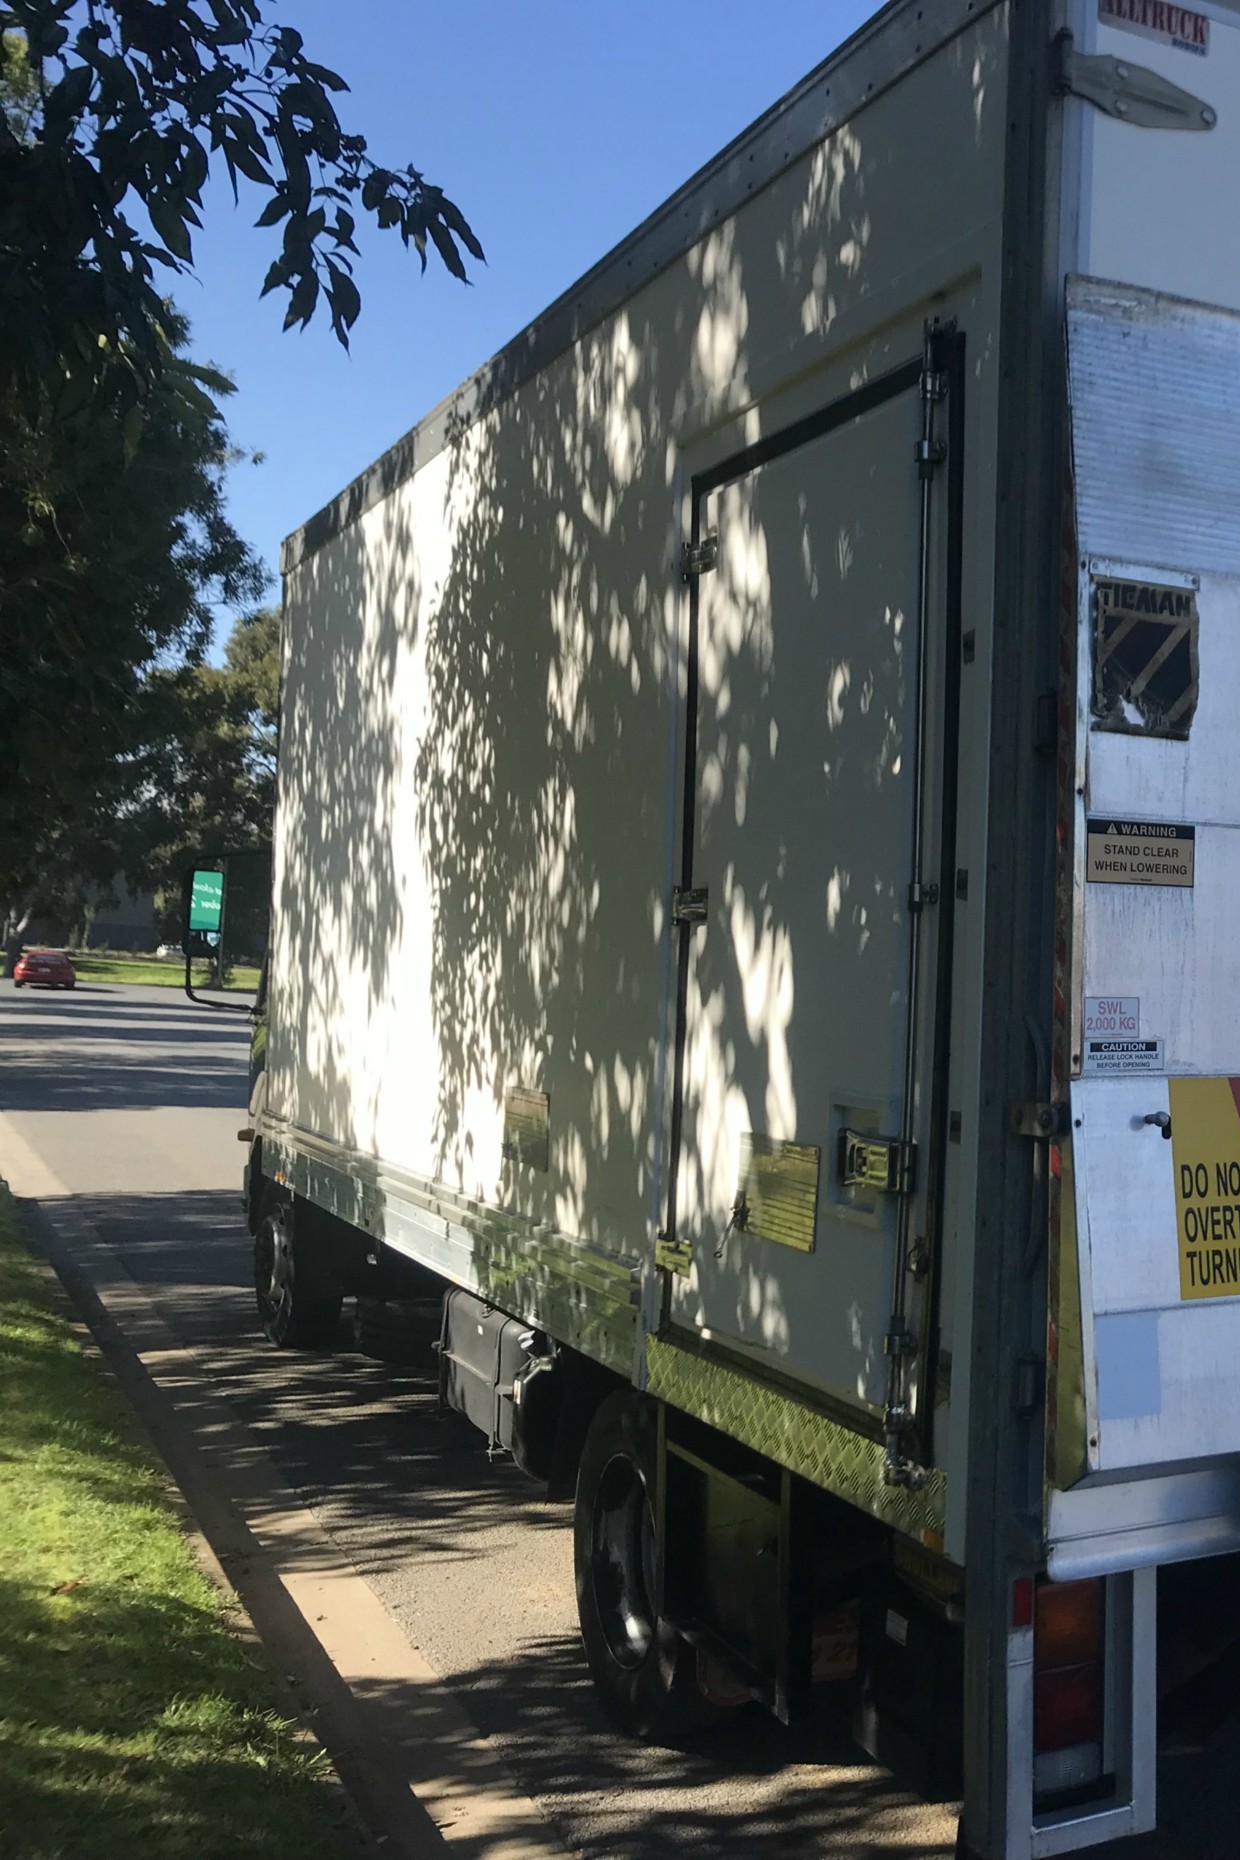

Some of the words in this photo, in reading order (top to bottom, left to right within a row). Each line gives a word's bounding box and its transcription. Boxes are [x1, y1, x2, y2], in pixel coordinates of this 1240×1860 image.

[1099, 582, 1191, 617] TIEMAN
[1121, 823, 1177, 838] WARNING
[1104, 844, 1140, 856] STAND
[1143, 846, 1179, 858] CLEAR
[1094, 860, 1127, 872] WHEN
[1130, 862, 1188, 875] LOWERING
[1098, 1001, 1127, 1015] SWL
[1086, 1017, 1116, 1032] 2,000
[1119, 1016, 1136, 1030] KG
[1102, 1042, 1146, 1051] CAUTION
[1088, 1053, 1116, 1061] RELEASE
[1181, 1163, 1209, 1199] DO
